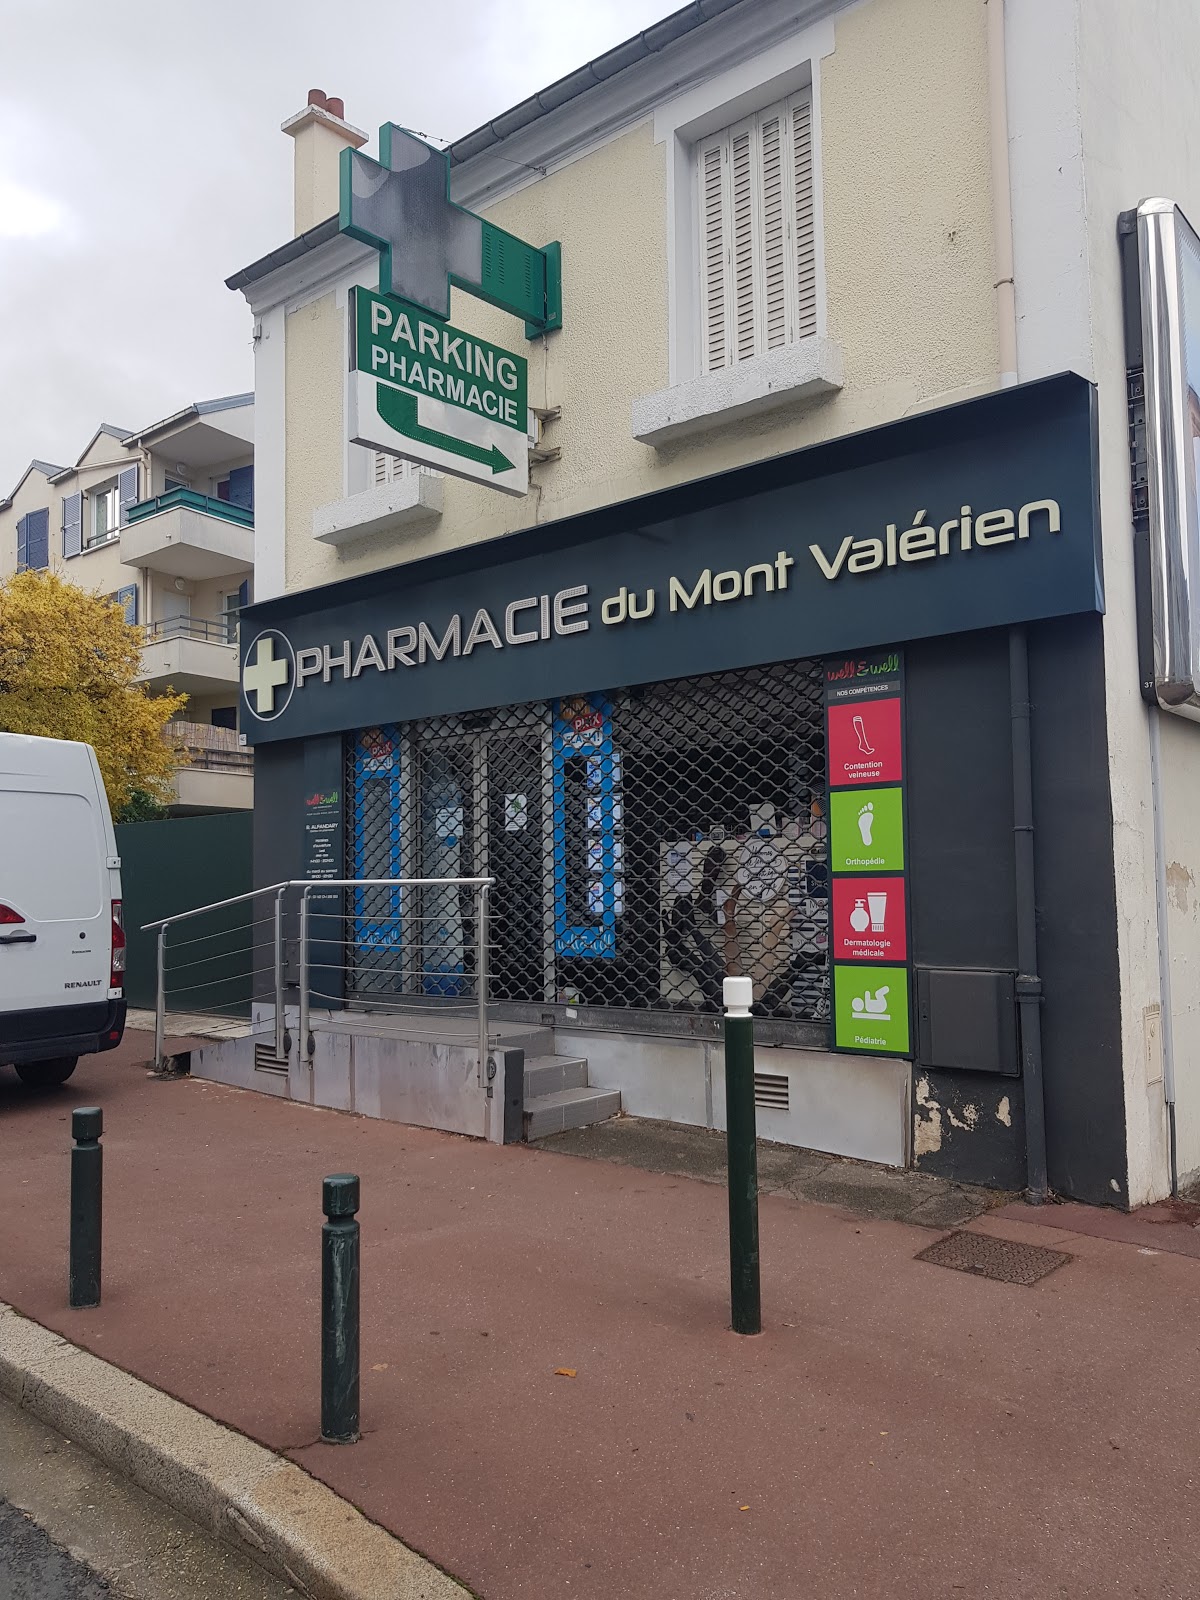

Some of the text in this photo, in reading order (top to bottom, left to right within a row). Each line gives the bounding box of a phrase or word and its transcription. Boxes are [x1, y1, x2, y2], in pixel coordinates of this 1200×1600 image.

[371, 300, 518, 391] PARKING
[371, 344, 518, 426] PHARMACIE
[296, 498, 1061, 688] PHARMACIE du Mont Valérien
[848, 684, 889, 695] COMPÉTENCES
[1144, 681, 1154, 689] 37
[844, 760, 883, 771] Contention
[848, 770, 880, 779] veineuse
[845, 857, 885, 866] Orthopédie
[843, 938, 891, 948] Dermatologie
[852, 949, 885, 957] médicale
[64, 979, 102, 989] RENAULT
[854, 1035, 887, 1046] Pédiatrie
